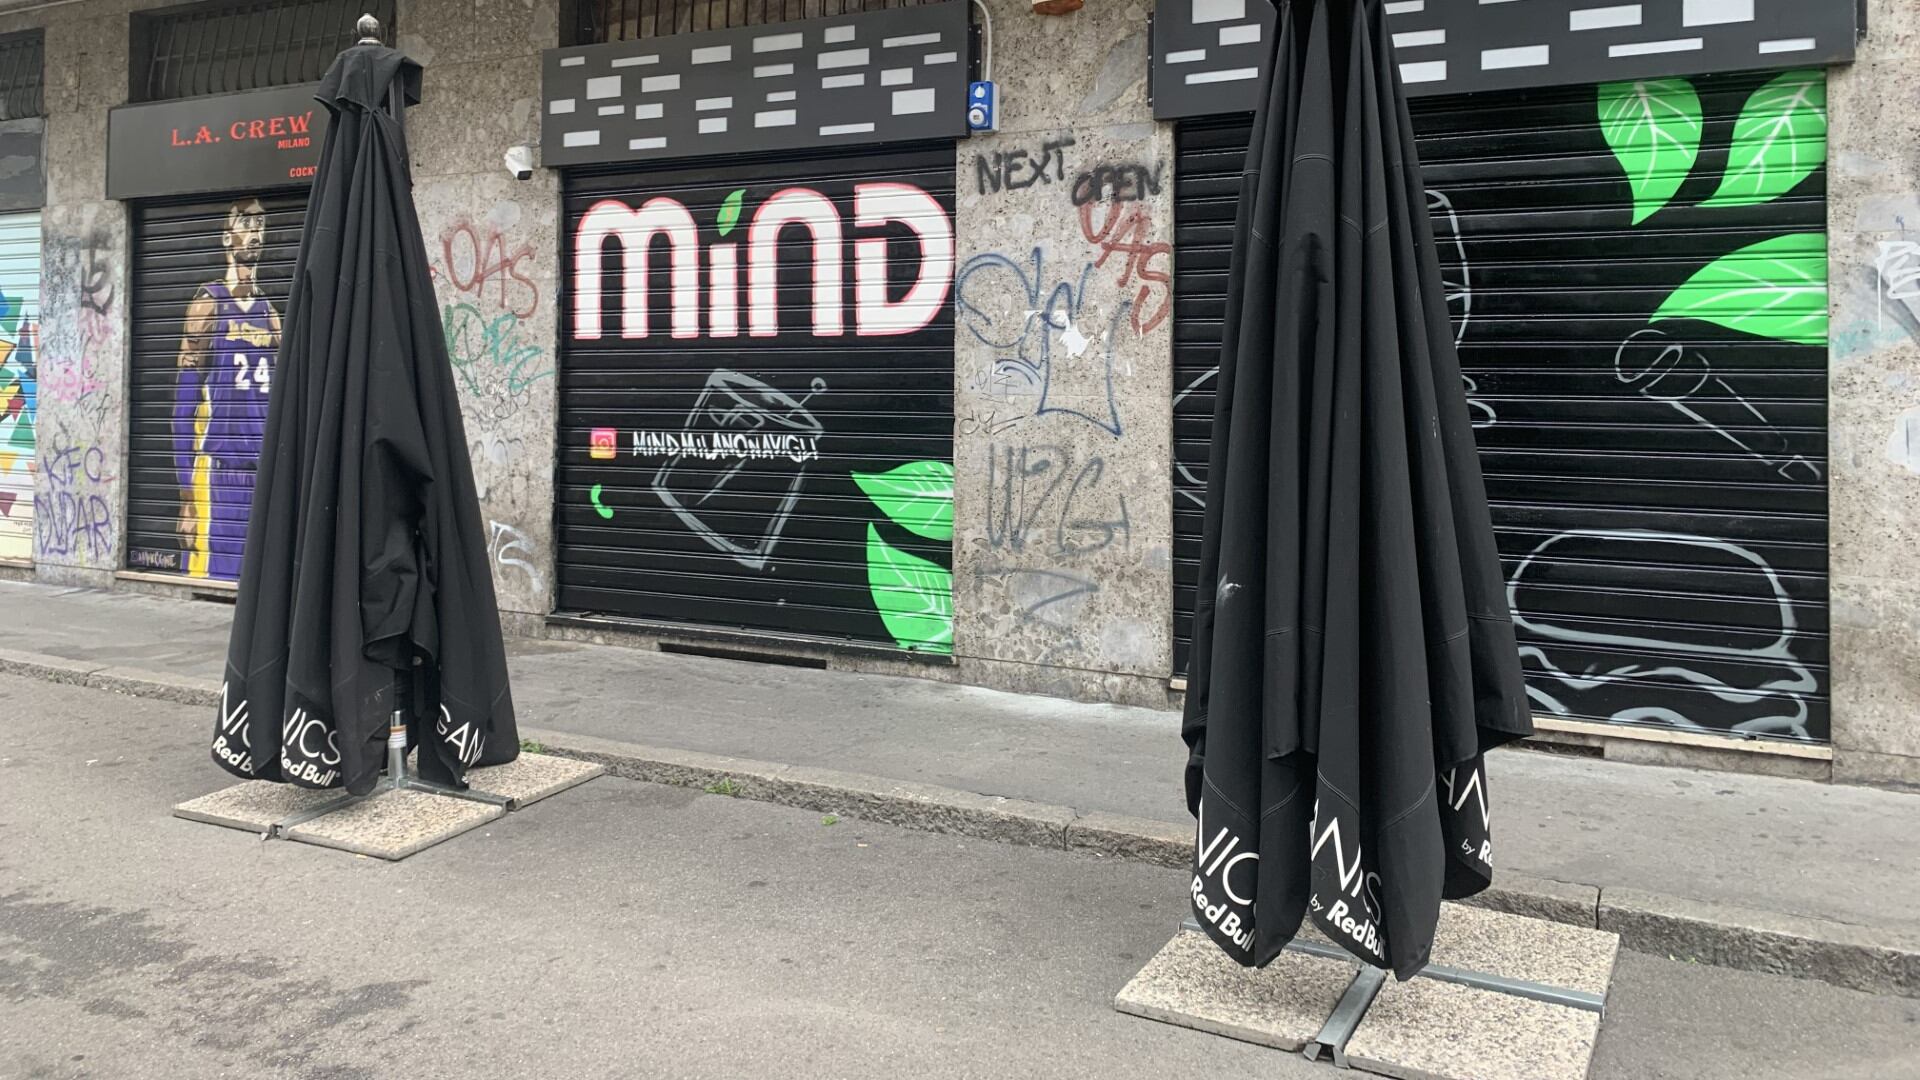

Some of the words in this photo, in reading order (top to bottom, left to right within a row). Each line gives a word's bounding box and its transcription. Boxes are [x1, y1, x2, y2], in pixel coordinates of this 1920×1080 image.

[171, 126, 222, 147] L.A.
[230, 111, 314, 141] CREW
[277, 137, 311, 149] MILANO
[976, 137, 1076, 196] NEXT
[1072, 160, 1164, 206] OPEN
[233, 353, 270, 393] 24
[43, 446, 104, 491] KFC
[301, 763, 336, 787] Bull
[1461, 838, 1476, 855] by
[1478, 839, 1493, 867] Re
[1191, 874, 1229, 924] Red
[1310, 893, 1325, 912] by
[1326, 899, 1370, 943] Red
